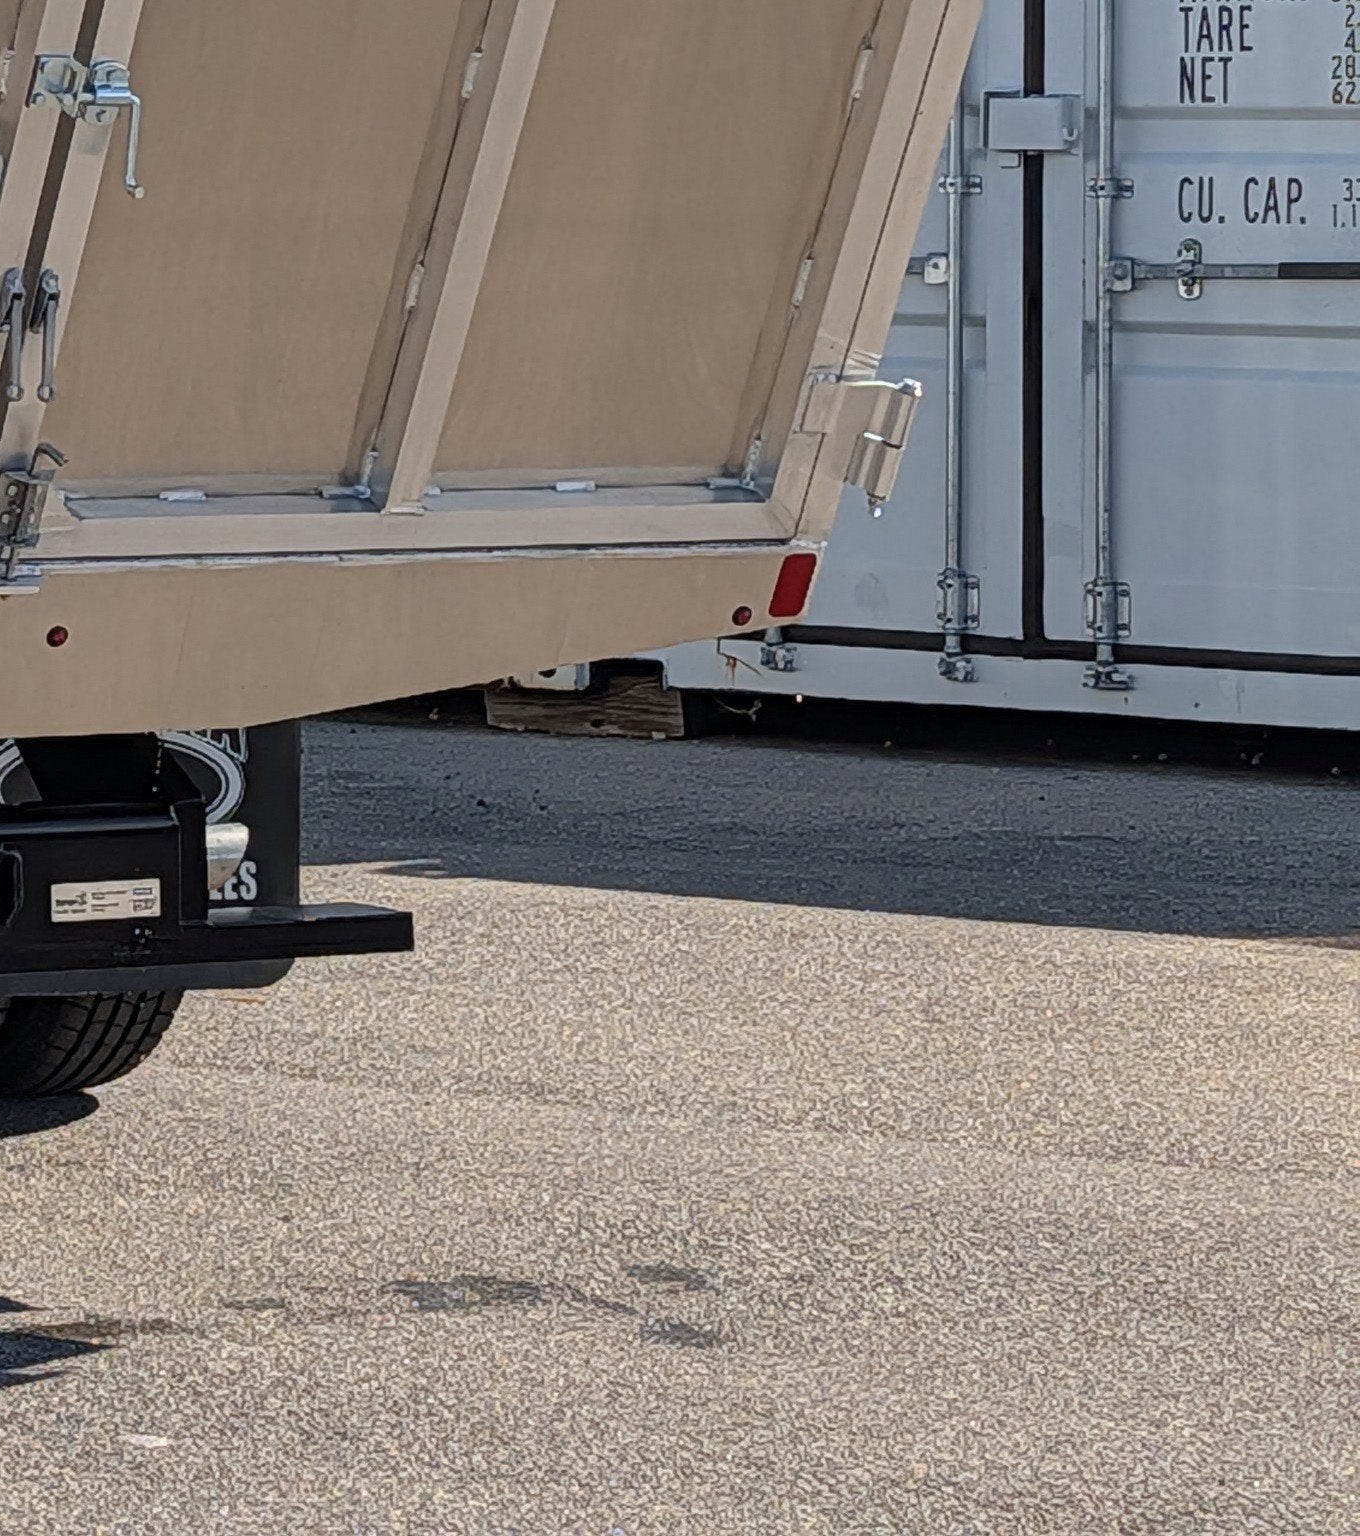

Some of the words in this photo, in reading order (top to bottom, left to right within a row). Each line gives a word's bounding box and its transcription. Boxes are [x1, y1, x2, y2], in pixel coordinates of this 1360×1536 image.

[1179, 5, 1254, 54] TARE
[1179, 56, 1233, 104] NET
[1178, 176, 1226, 224] CU.
[1243, 176, 1307, 224] CAP.
